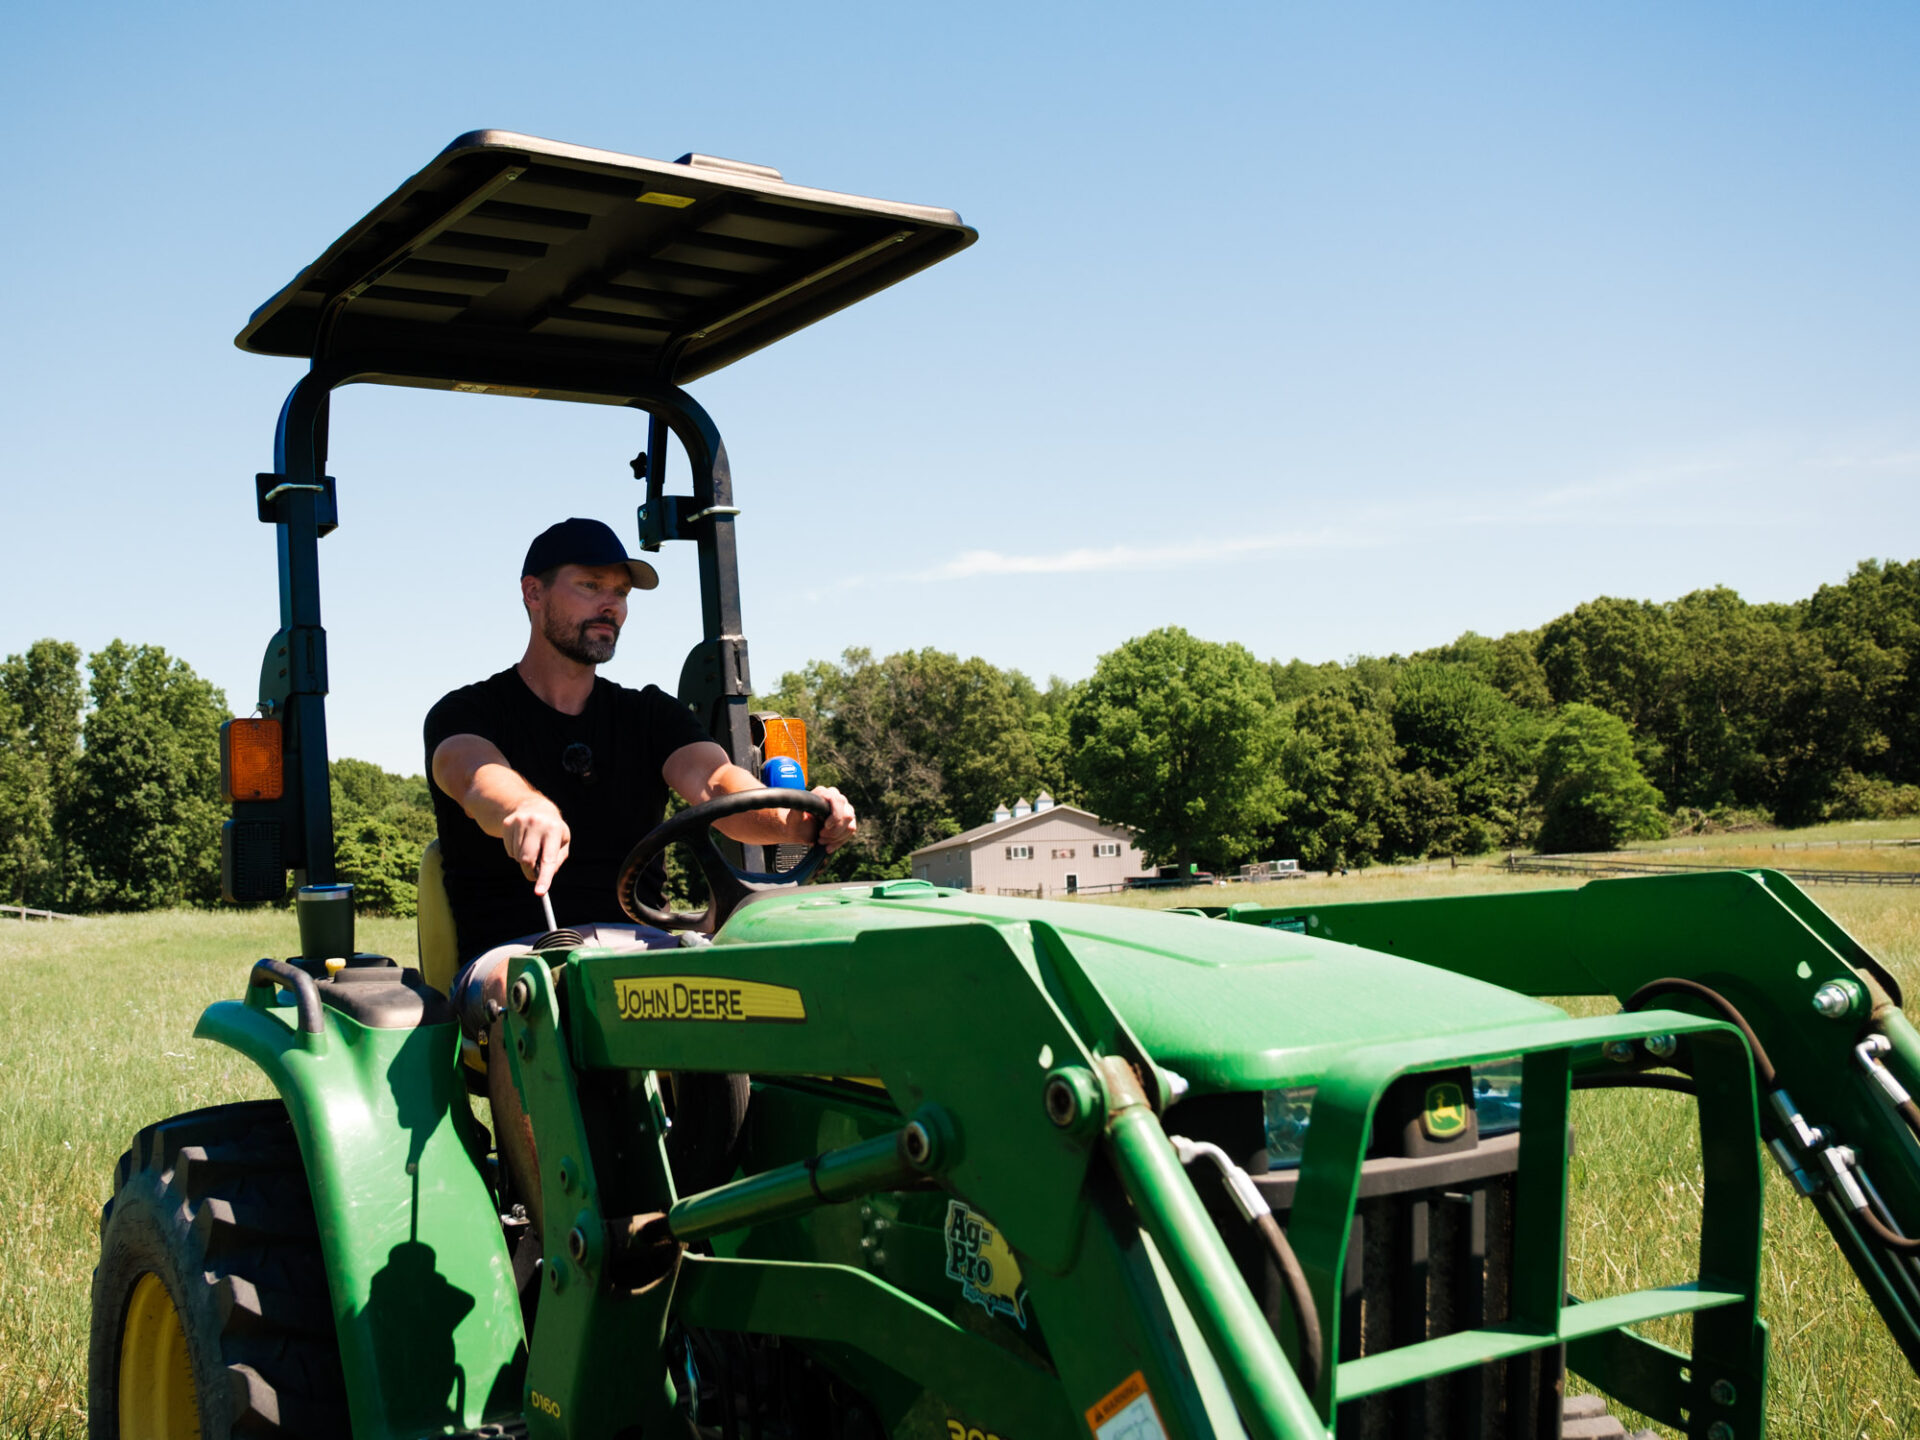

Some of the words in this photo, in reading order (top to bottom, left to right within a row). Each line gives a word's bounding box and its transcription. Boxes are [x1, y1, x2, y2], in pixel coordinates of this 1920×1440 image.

[620, 984, 669, 1015] JOHN
[673, 982, 743, 1015] DEERE
[950, 1205, 991, 1254] Ag-
[950, 1240, 991, 1284] Pro
[531, 1390, 561, 1419] D160
